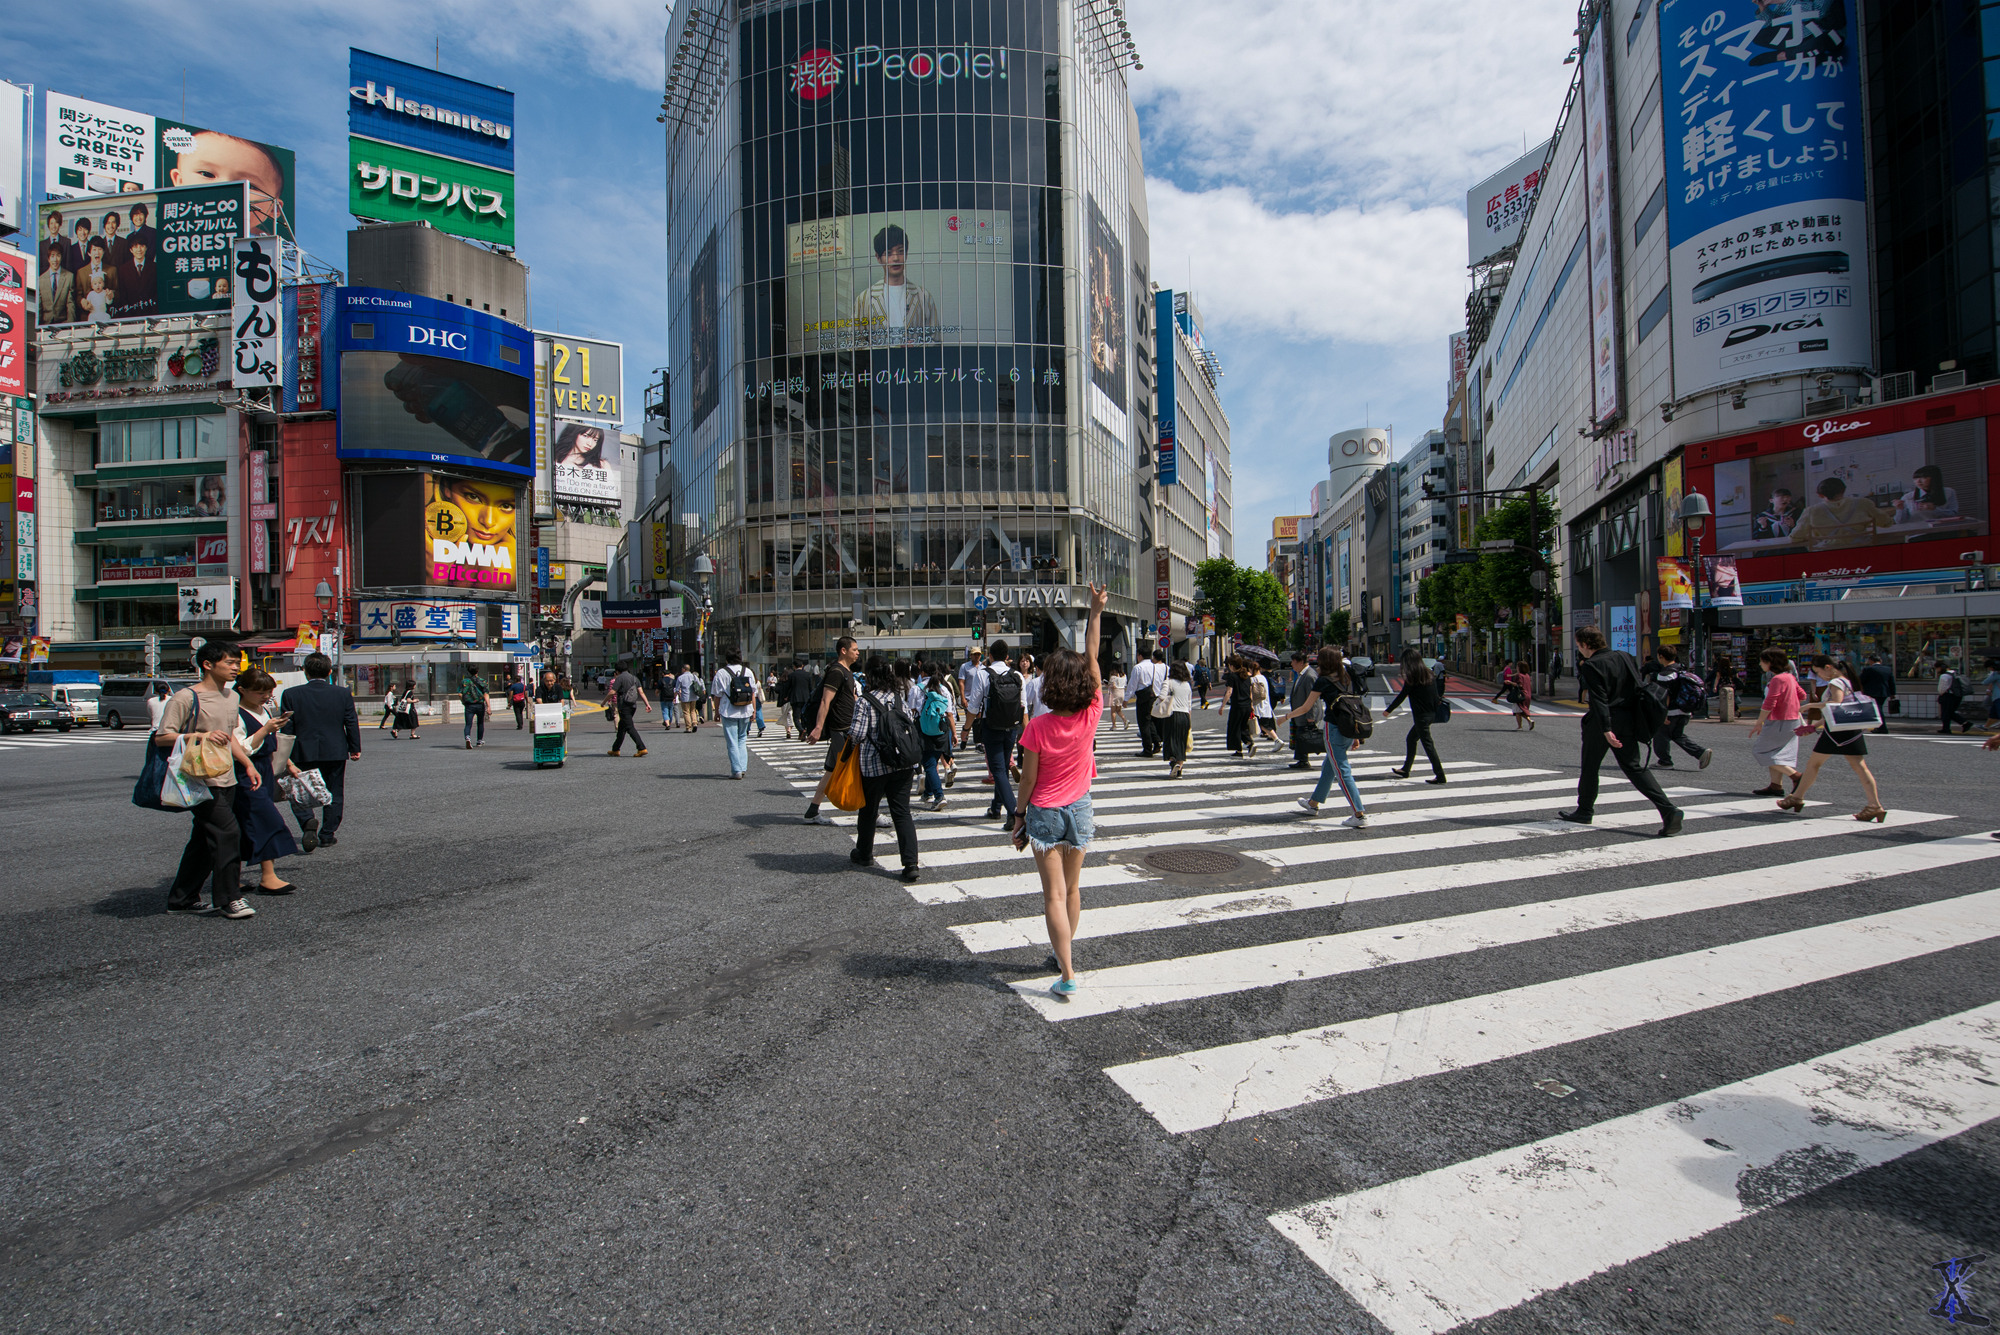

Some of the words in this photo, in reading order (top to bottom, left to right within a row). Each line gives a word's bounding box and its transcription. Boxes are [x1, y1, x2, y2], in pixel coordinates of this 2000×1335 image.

[1678, 10, 1726, 48] その
[853, 42, 1008, 86] People!
[1679, 4, 1844, 95] スマホ、
[789, 57, 845, 93] 渋谷
[1681, 49, 1844, 125] ディーガが
[59, 107, 145, 136] 関ジャニ∞
[350, 80, 511, 141] Hisamitsu
[59, 134, 144, 162] GR8EST
[60, 123, 144, 149] ベストアルバム
[1682, 101, 1845, 175] 軽くして
[74, 153, 133, 175] 発売中!
[1684, 139, 1848, 204] あげましょう!
[357, 160, 507, 219] サロンパス
[1487, 167, 1546, 214] 広告募
[163, 199, 238, 220] 関ジャニ∞
[163, 217, 237, 233] ベストアルバム
[1697, 215, 1841, 259] スマホの写真や動画は
[162, 232, 238, 253] GR8EST
[1698, 231, 1842, 273] ディーガにためられる!
[175, 255, 228, 273] 発売中!
[235, 241, 277, 383] もんじゃ
[347, 296, 369, 305] DHC
[370, 297, 412, 309] Channel
[1695, 288, 1847, 333] おうちクラウド
[408, 325, 468, 352] DHC
[1721, 318, 1824, 349] DIGA
[553, 344, 590, 386] 21
[822, 366, 993, 391] 滞在中の仏ホテルで、
[597, 393, 616, 415] 21
[1134, 260, 1152, 554] TSUTAYA
[1160, 420, 1174, 473] SEIBU
[1803, 420, 1871, 443] Glico
[431, 454, 448, 462] DHC
[254, 454, 263, 501] お好み焼
[19, 490, 33, 499] JTB
[105, 503, 190, 520] Euphoria
[200, 539, 227, 559] JTB
[254, 522, 264, 570] もんじゃ焼
[286, 500, 339, 573] クスリ
[433, 538, 512, 569] DMM
[104, 570, 129, 578] 国内旅行
[134, 569, 160, 577] 海外旅行
[432, 564, 511, 584] Bitcoin
[969, 587, 1068, 606] TSUTAYA
[1923, 621, 1962, 631] Free
